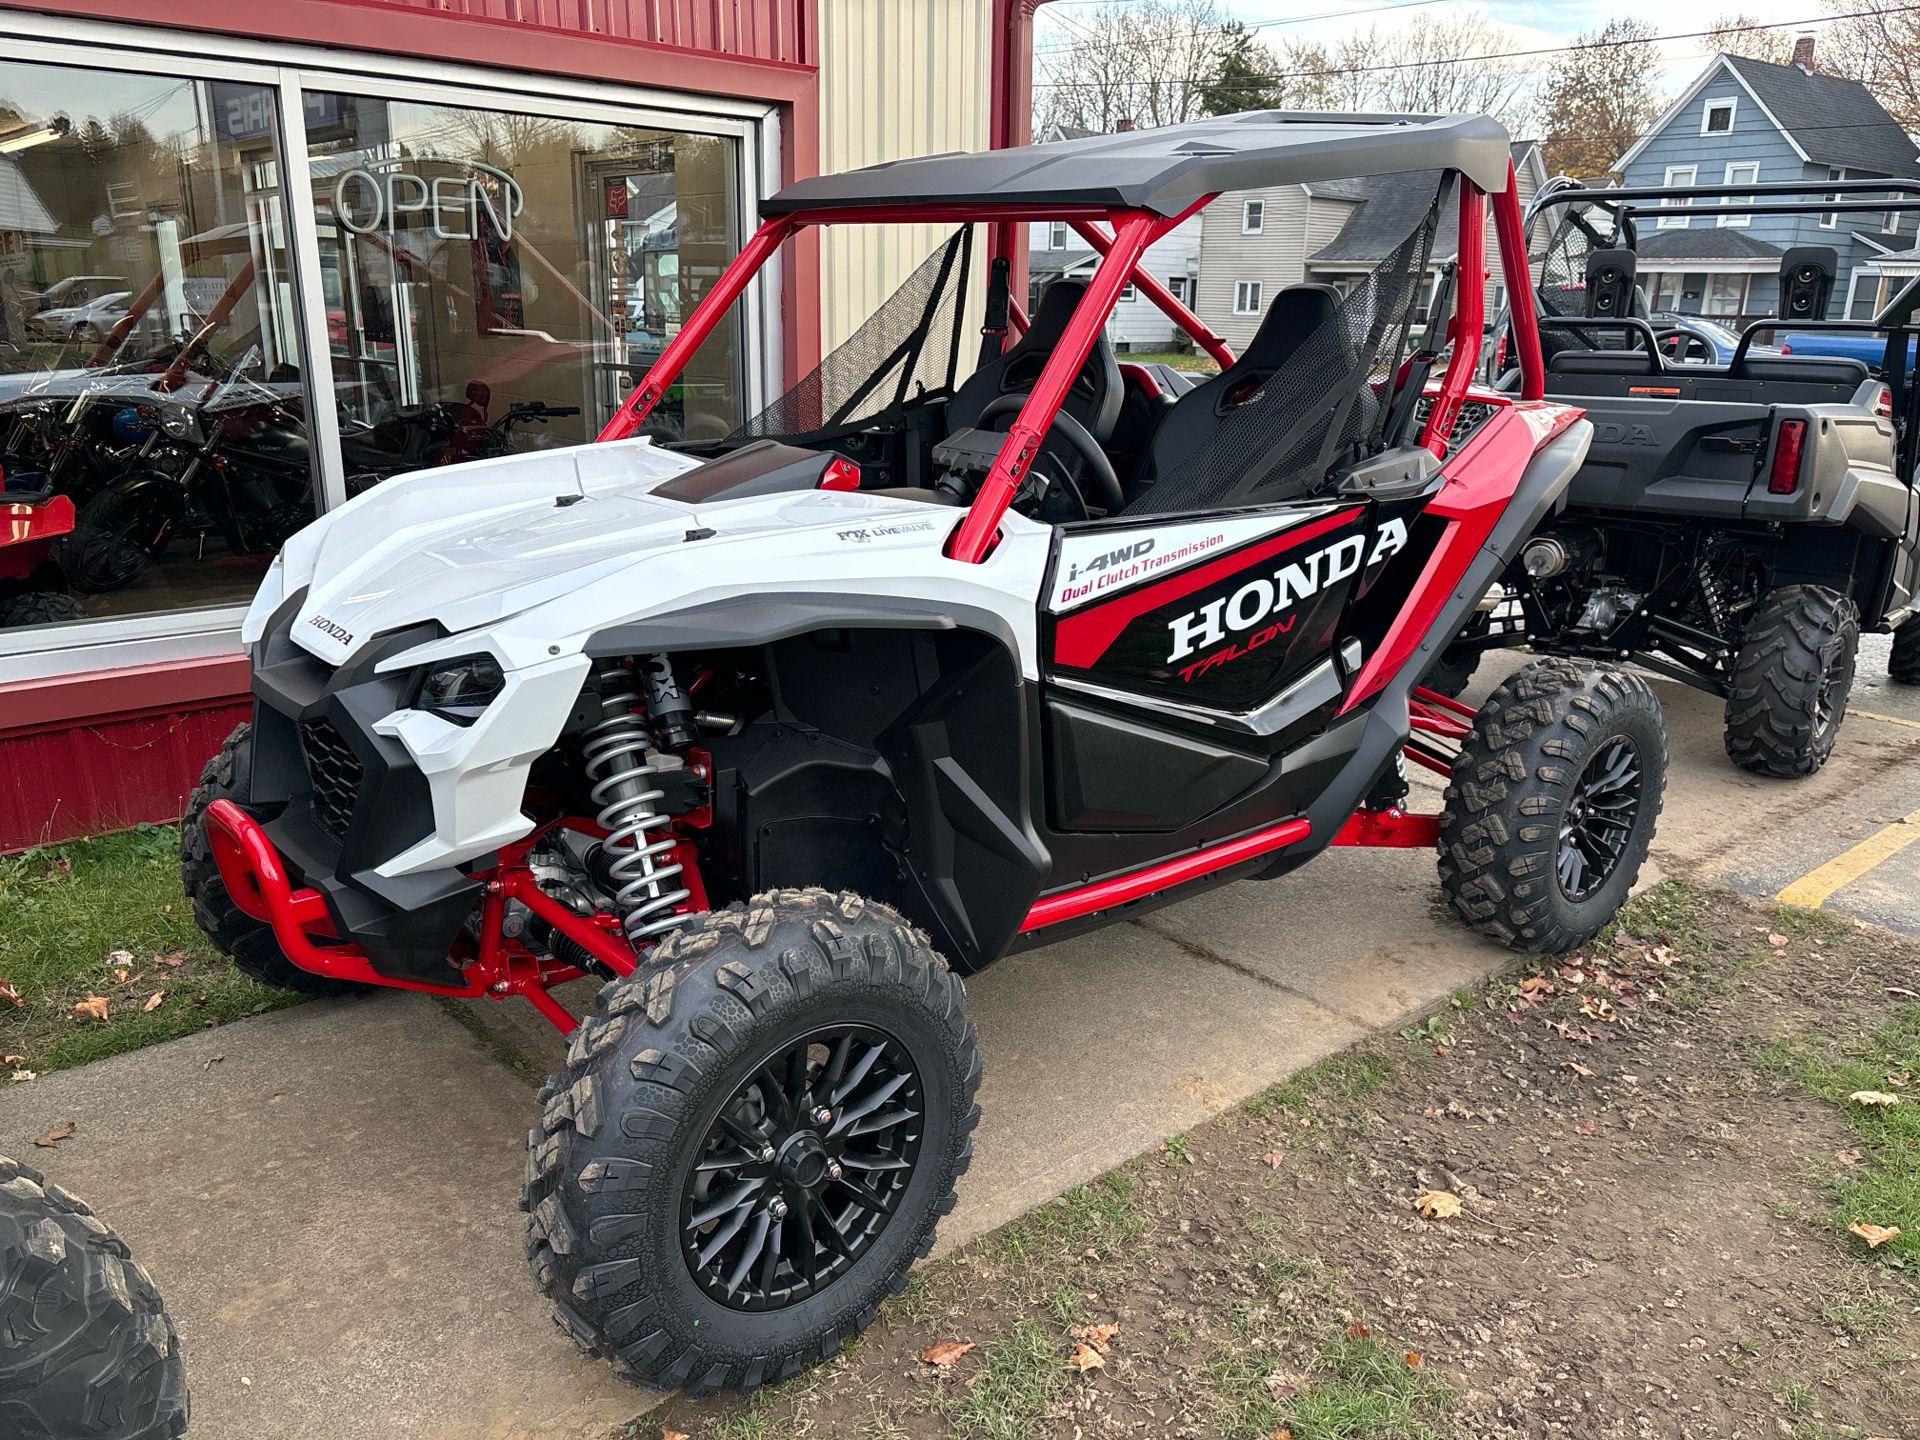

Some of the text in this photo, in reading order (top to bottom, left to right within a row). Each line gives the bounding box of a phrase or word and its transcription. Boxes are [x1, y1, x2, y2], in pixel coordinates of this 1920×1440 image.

[336, 170, 513, 241] OPEN
[836, 529, 871, 543] FOX
[1061, 534, 1224, 603] Dual Clutch Transmission
[1067, 538, 1155, 582] i-4WD
[1167, 517, 1408, 664] HONDA
[308, 614, 354, 646] HONDA
[1176, 613, 1297, 683] TALON
